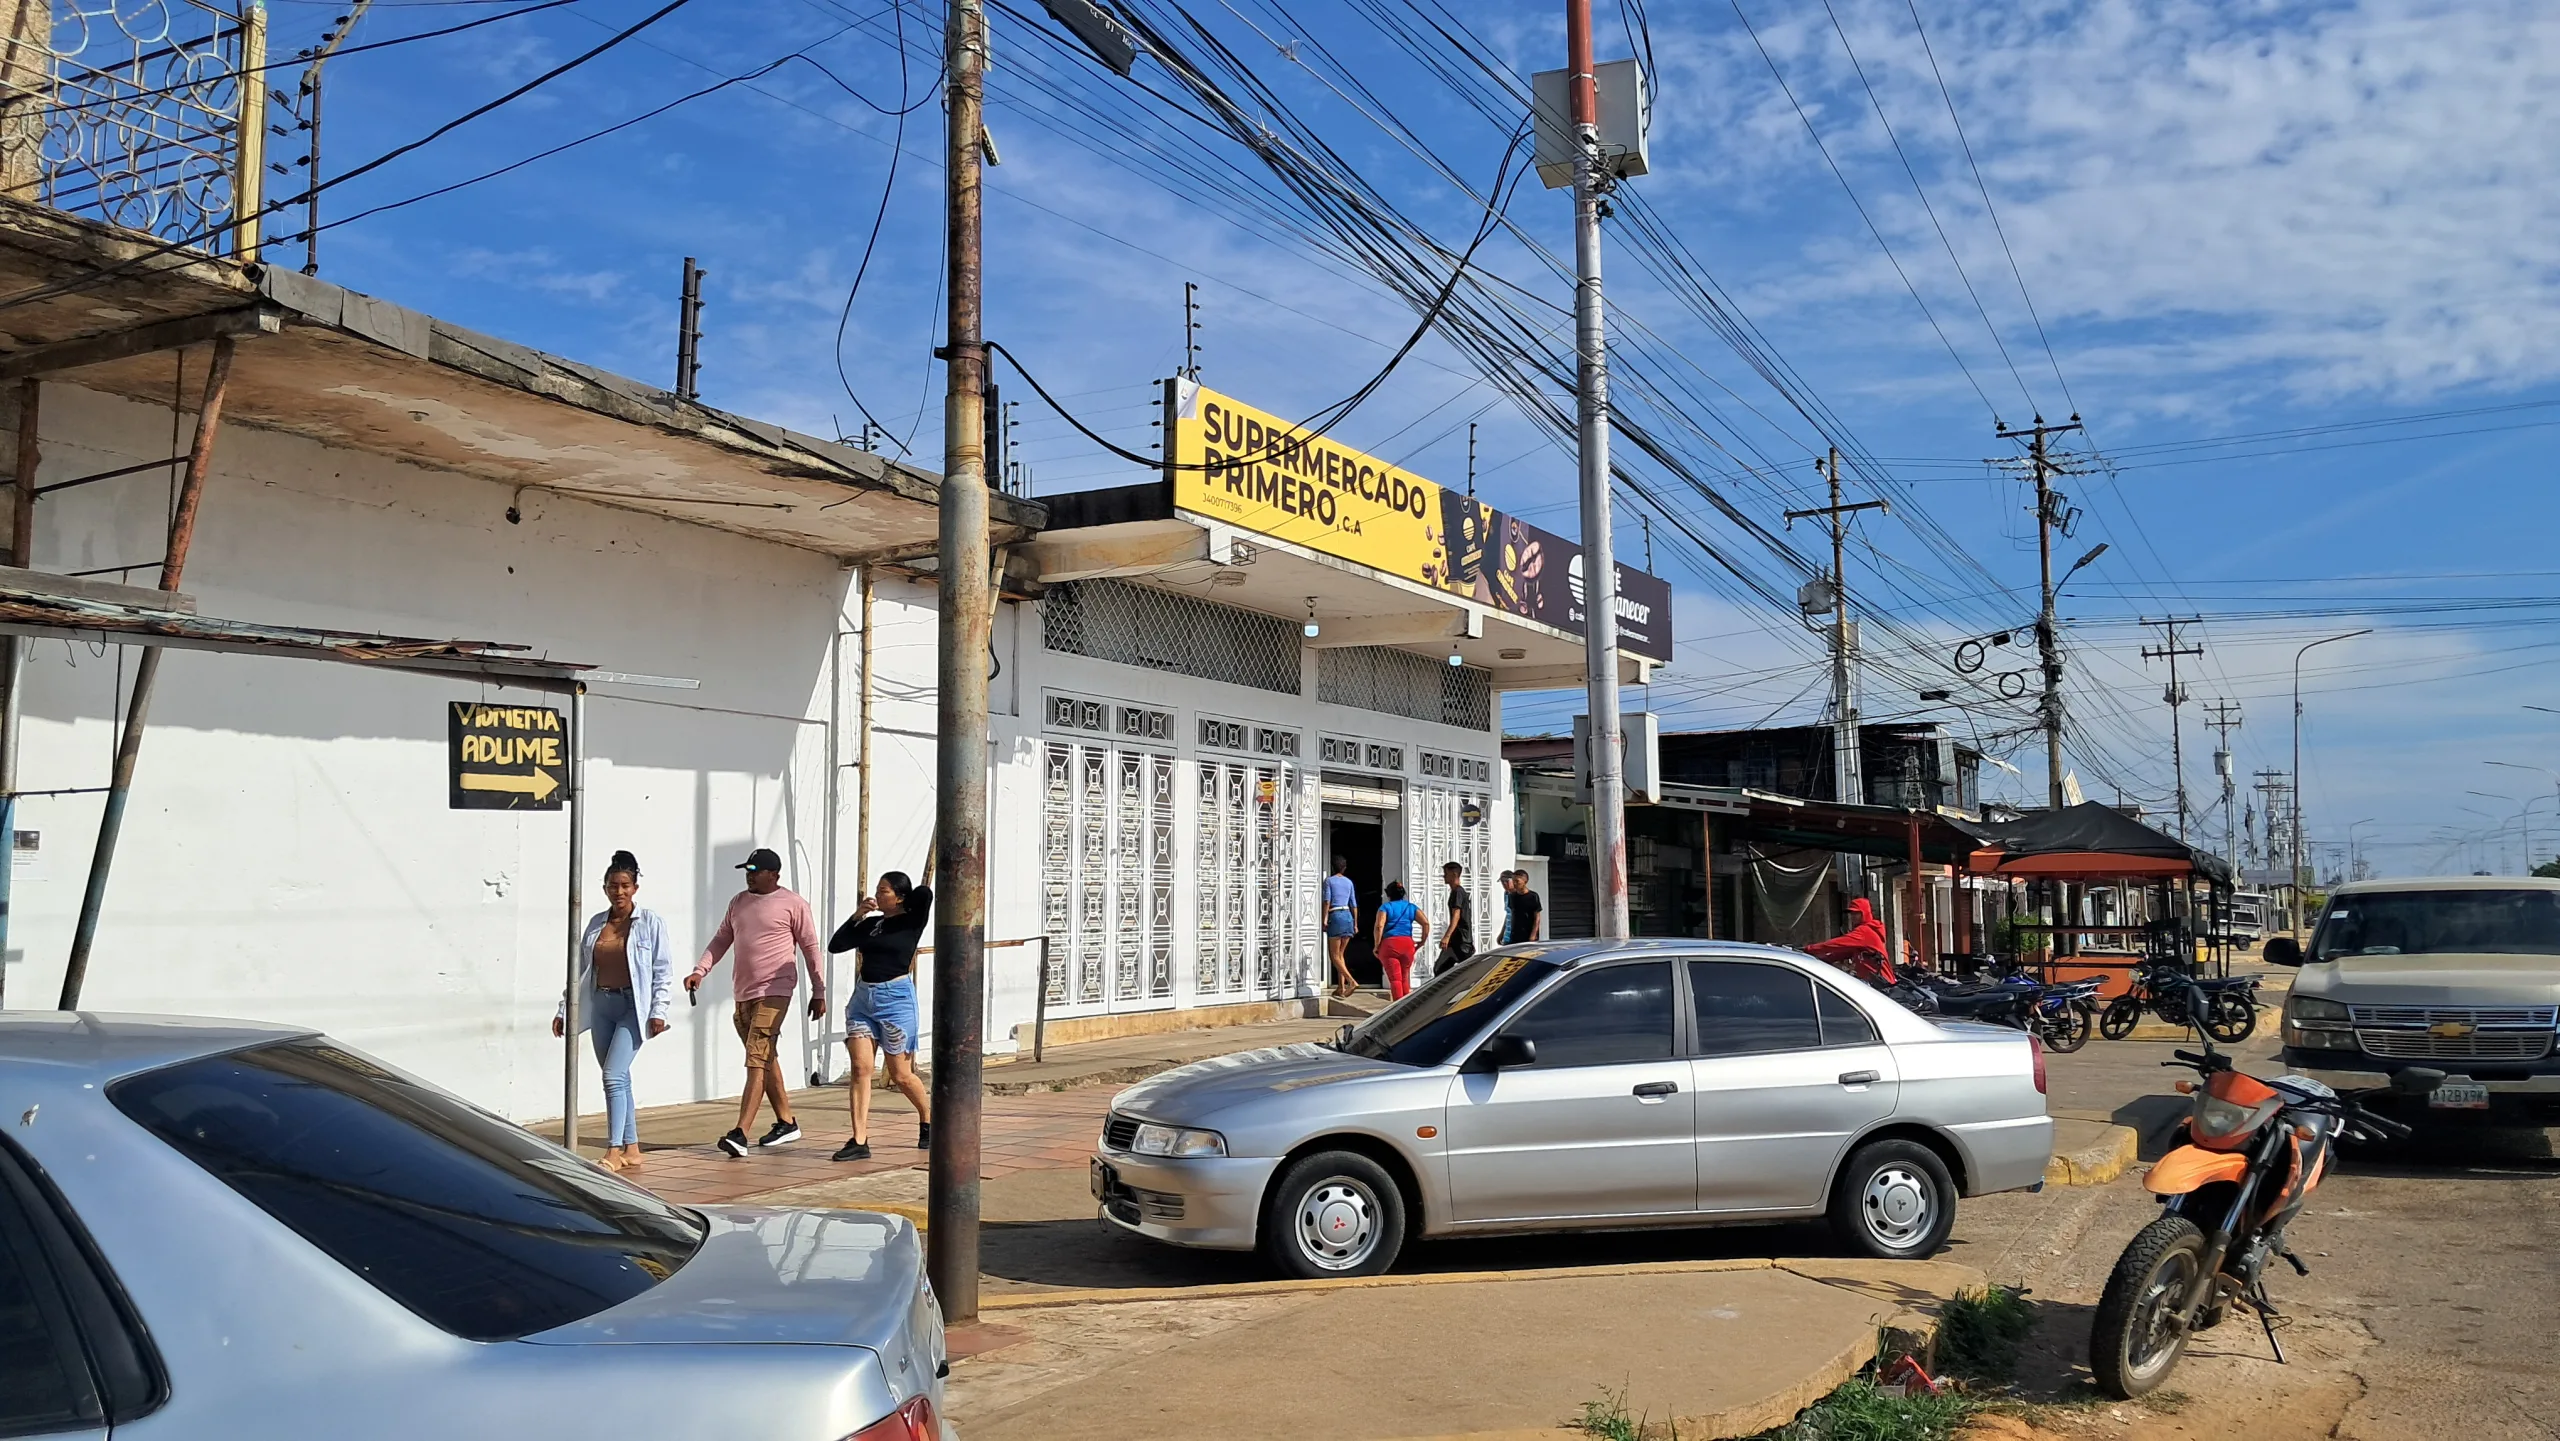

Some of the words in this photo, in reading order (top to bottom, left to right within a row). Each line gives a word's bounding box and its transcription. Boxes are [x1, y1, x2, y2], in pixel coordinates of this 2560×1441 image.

[1204, 402, 1426, 520] SUPERMERCADO
[1614, 595, 1651, 625] anecer
[462, 734, 562, 766] ADUME
